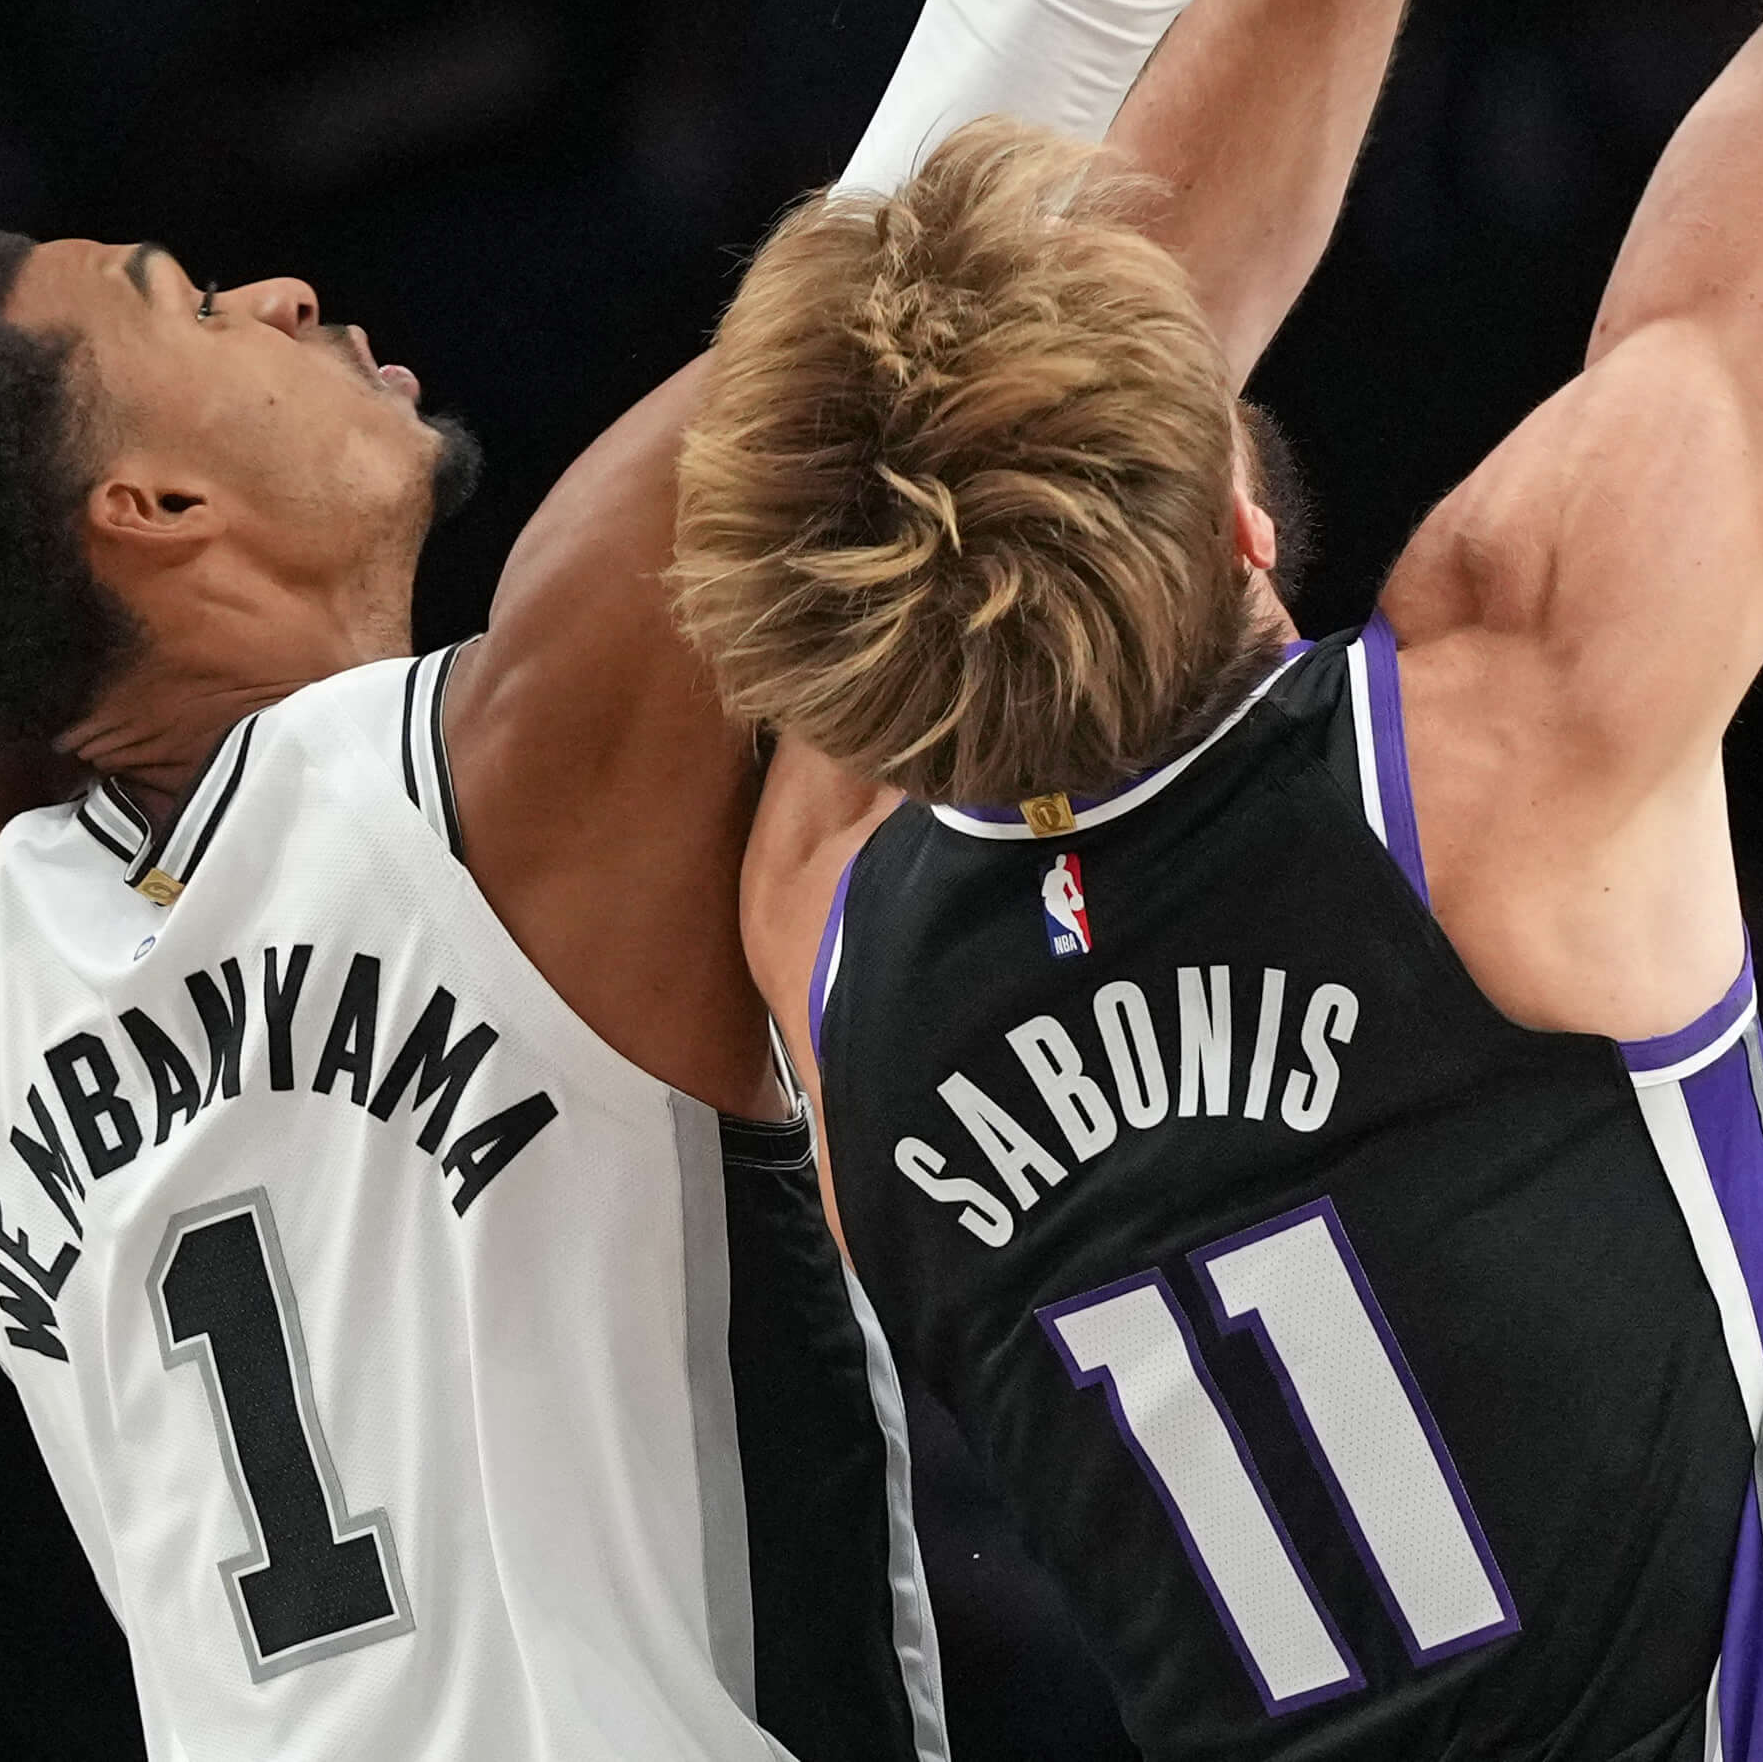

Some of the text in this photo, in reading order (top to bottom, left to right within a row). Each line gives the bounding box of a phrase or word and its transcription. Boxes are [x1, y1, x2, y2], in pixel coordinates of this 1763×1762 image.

[893, 964, 1360, 1249] SABONIS
[1054, 933, 1078, 955] NBA
[144, 1184, 417, 1686] 1
[1036, 1195, 1522, 1717] 11
